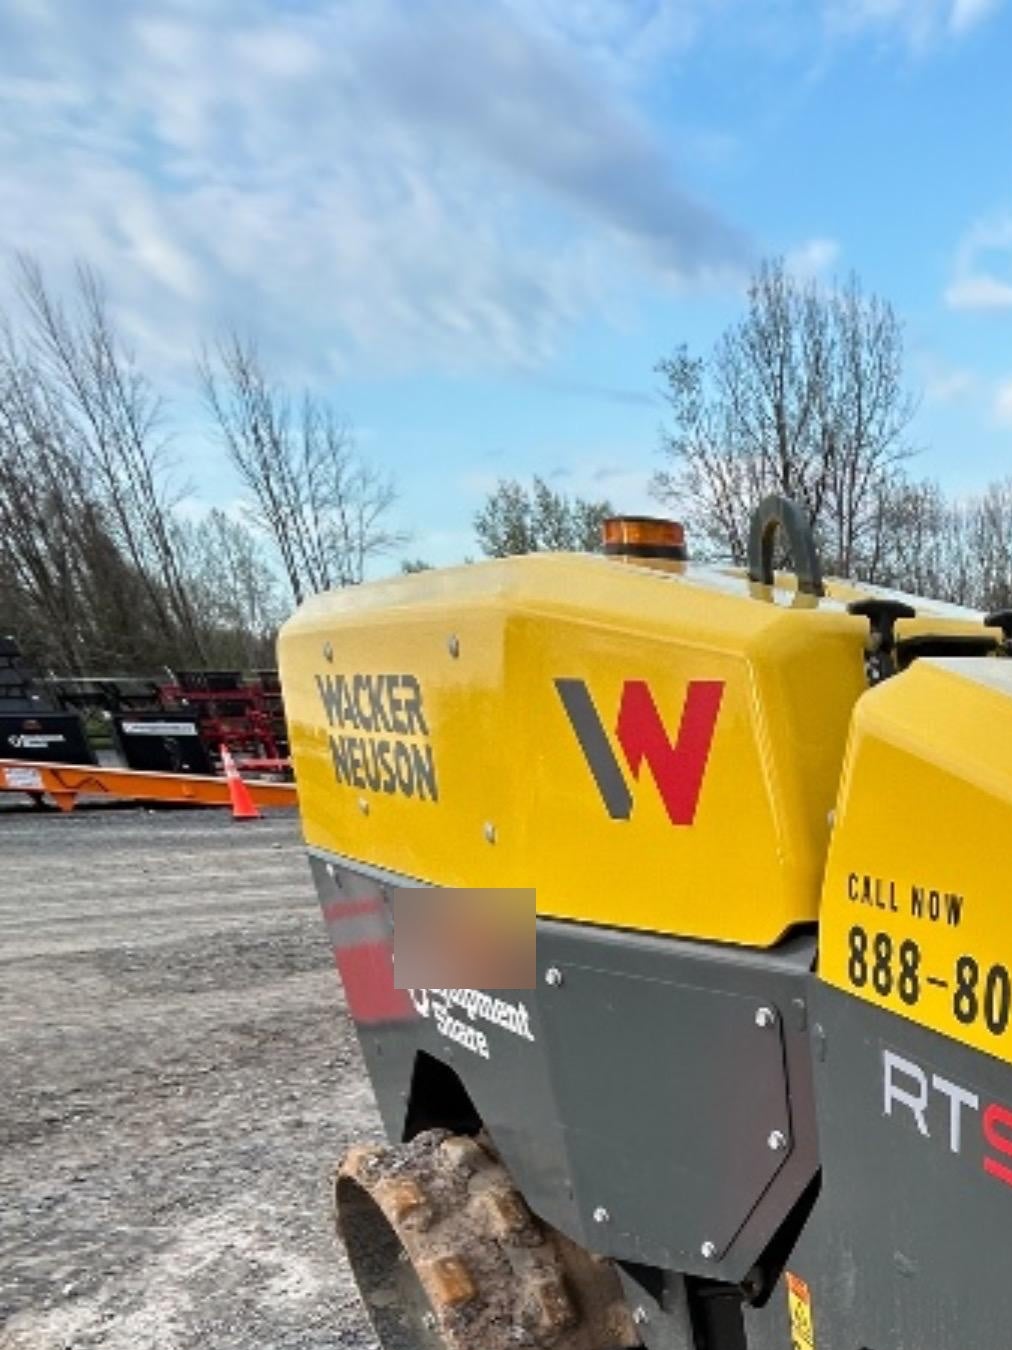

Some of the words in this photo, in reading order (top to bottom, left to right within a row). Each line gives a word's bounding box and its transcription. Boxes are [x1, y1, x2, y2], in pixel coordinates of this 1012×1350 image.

[315, 674, 430, 737] WACKER
[328, 734, 439, 802] NEUSON
[848, 872, 899, 913] CALL
[911, 884, 965, 928] NOW
